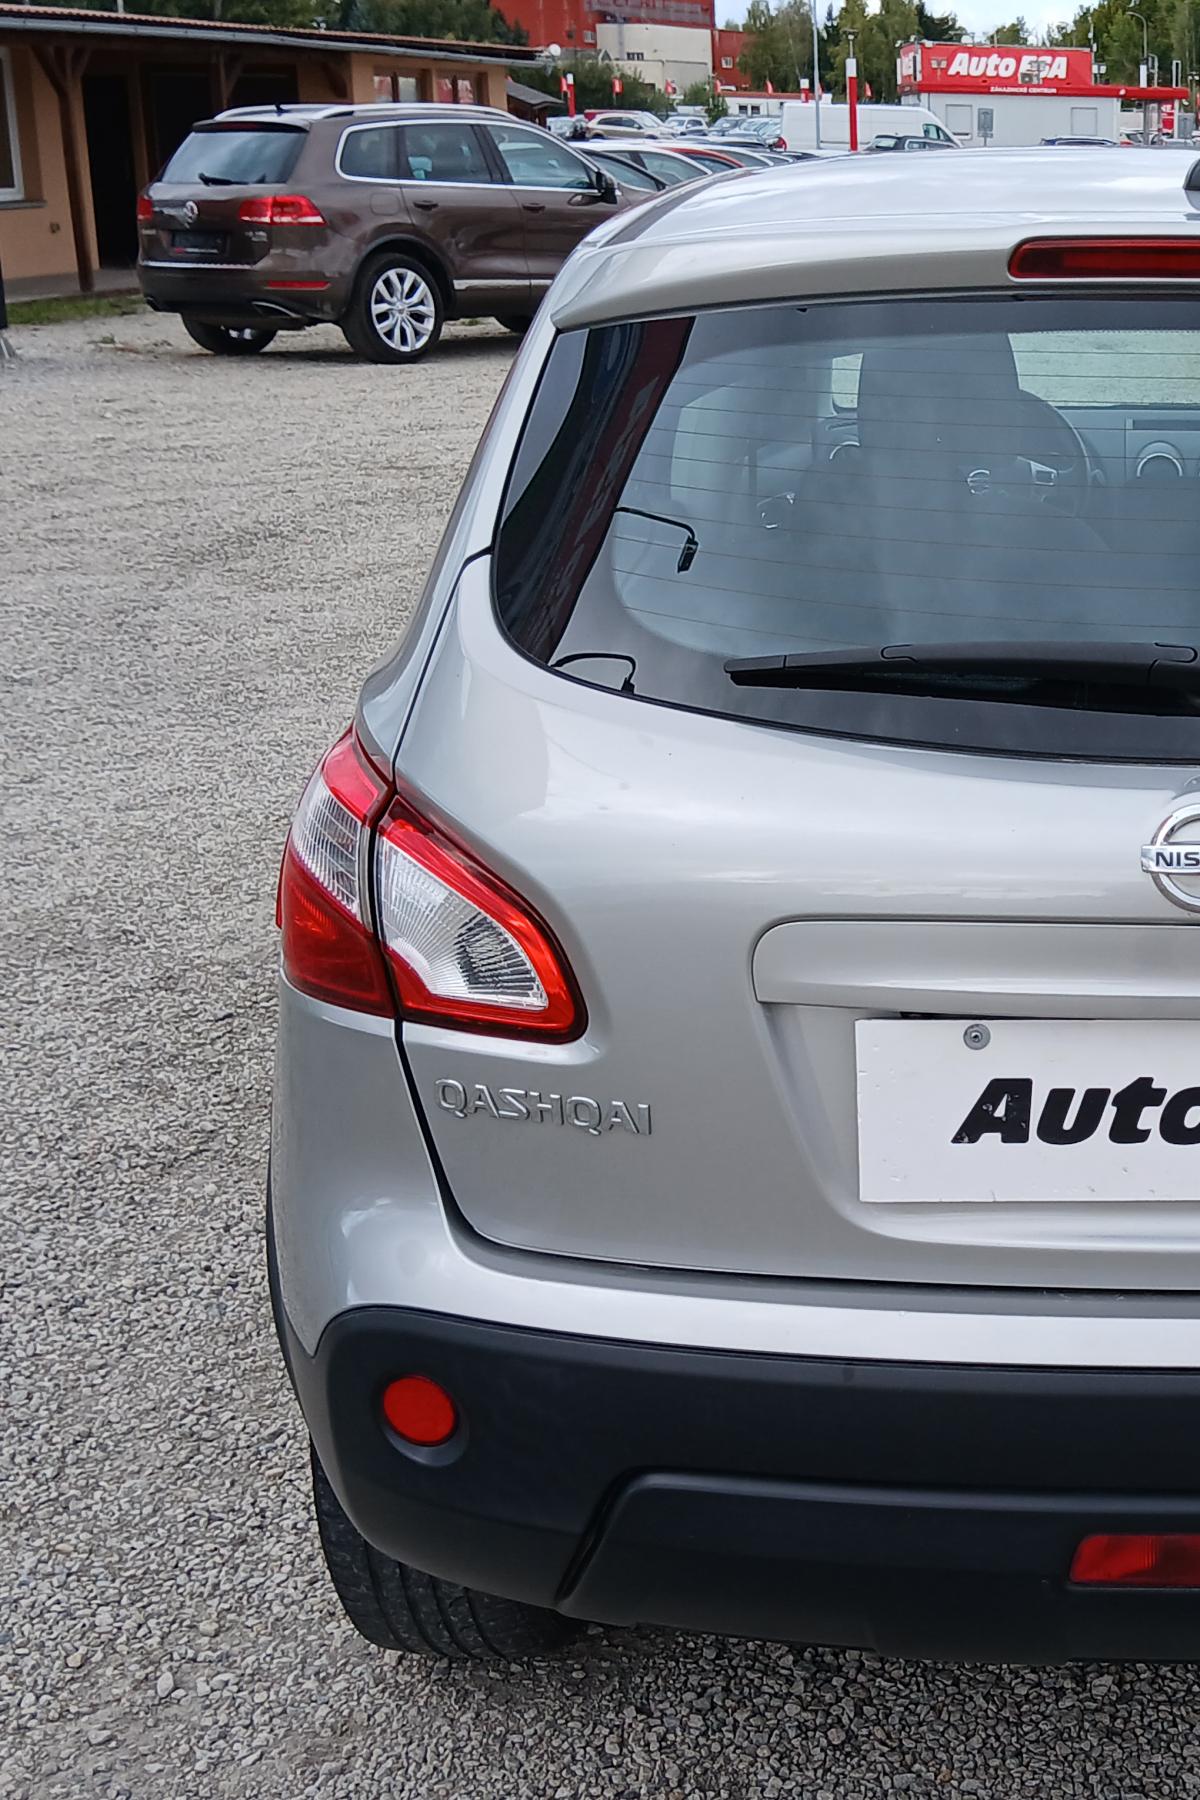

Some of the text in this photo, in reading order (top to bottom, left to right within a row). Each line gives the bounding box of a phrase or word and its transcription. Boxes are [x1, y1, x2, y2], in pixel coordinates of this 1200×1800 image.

[947, 53, 1068, 79] Auto ESA
[435, 1078, 652, 1136] QASHQAI
